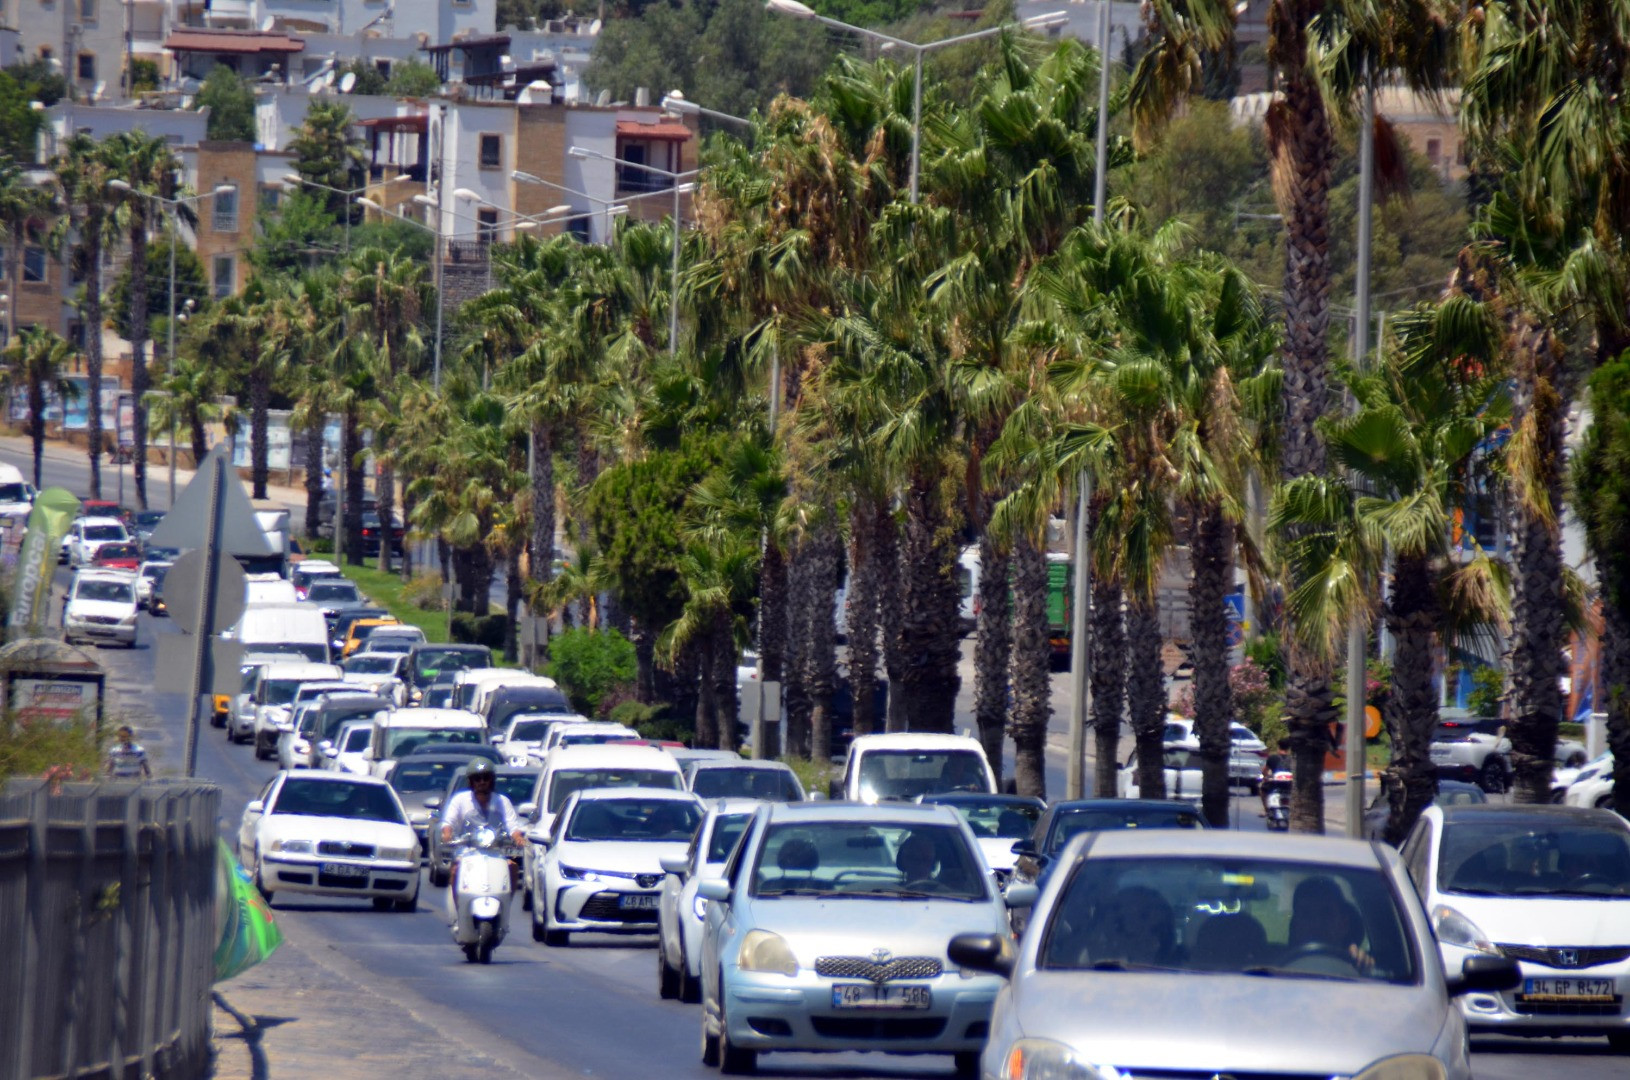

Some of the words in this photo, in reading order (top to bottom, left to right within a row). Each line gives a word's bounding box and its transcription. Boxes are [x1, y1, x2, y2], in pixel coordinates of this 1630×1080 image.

[11, 528, 46, 626] Europcar
[844, 986, 861, 1003] 48
[873, 986, 889, 1003] TY
[902, 987, 929, 1004] 586
[1533, 980, 1549, 994] 34
[1555, 980, 1570, 995] GP
